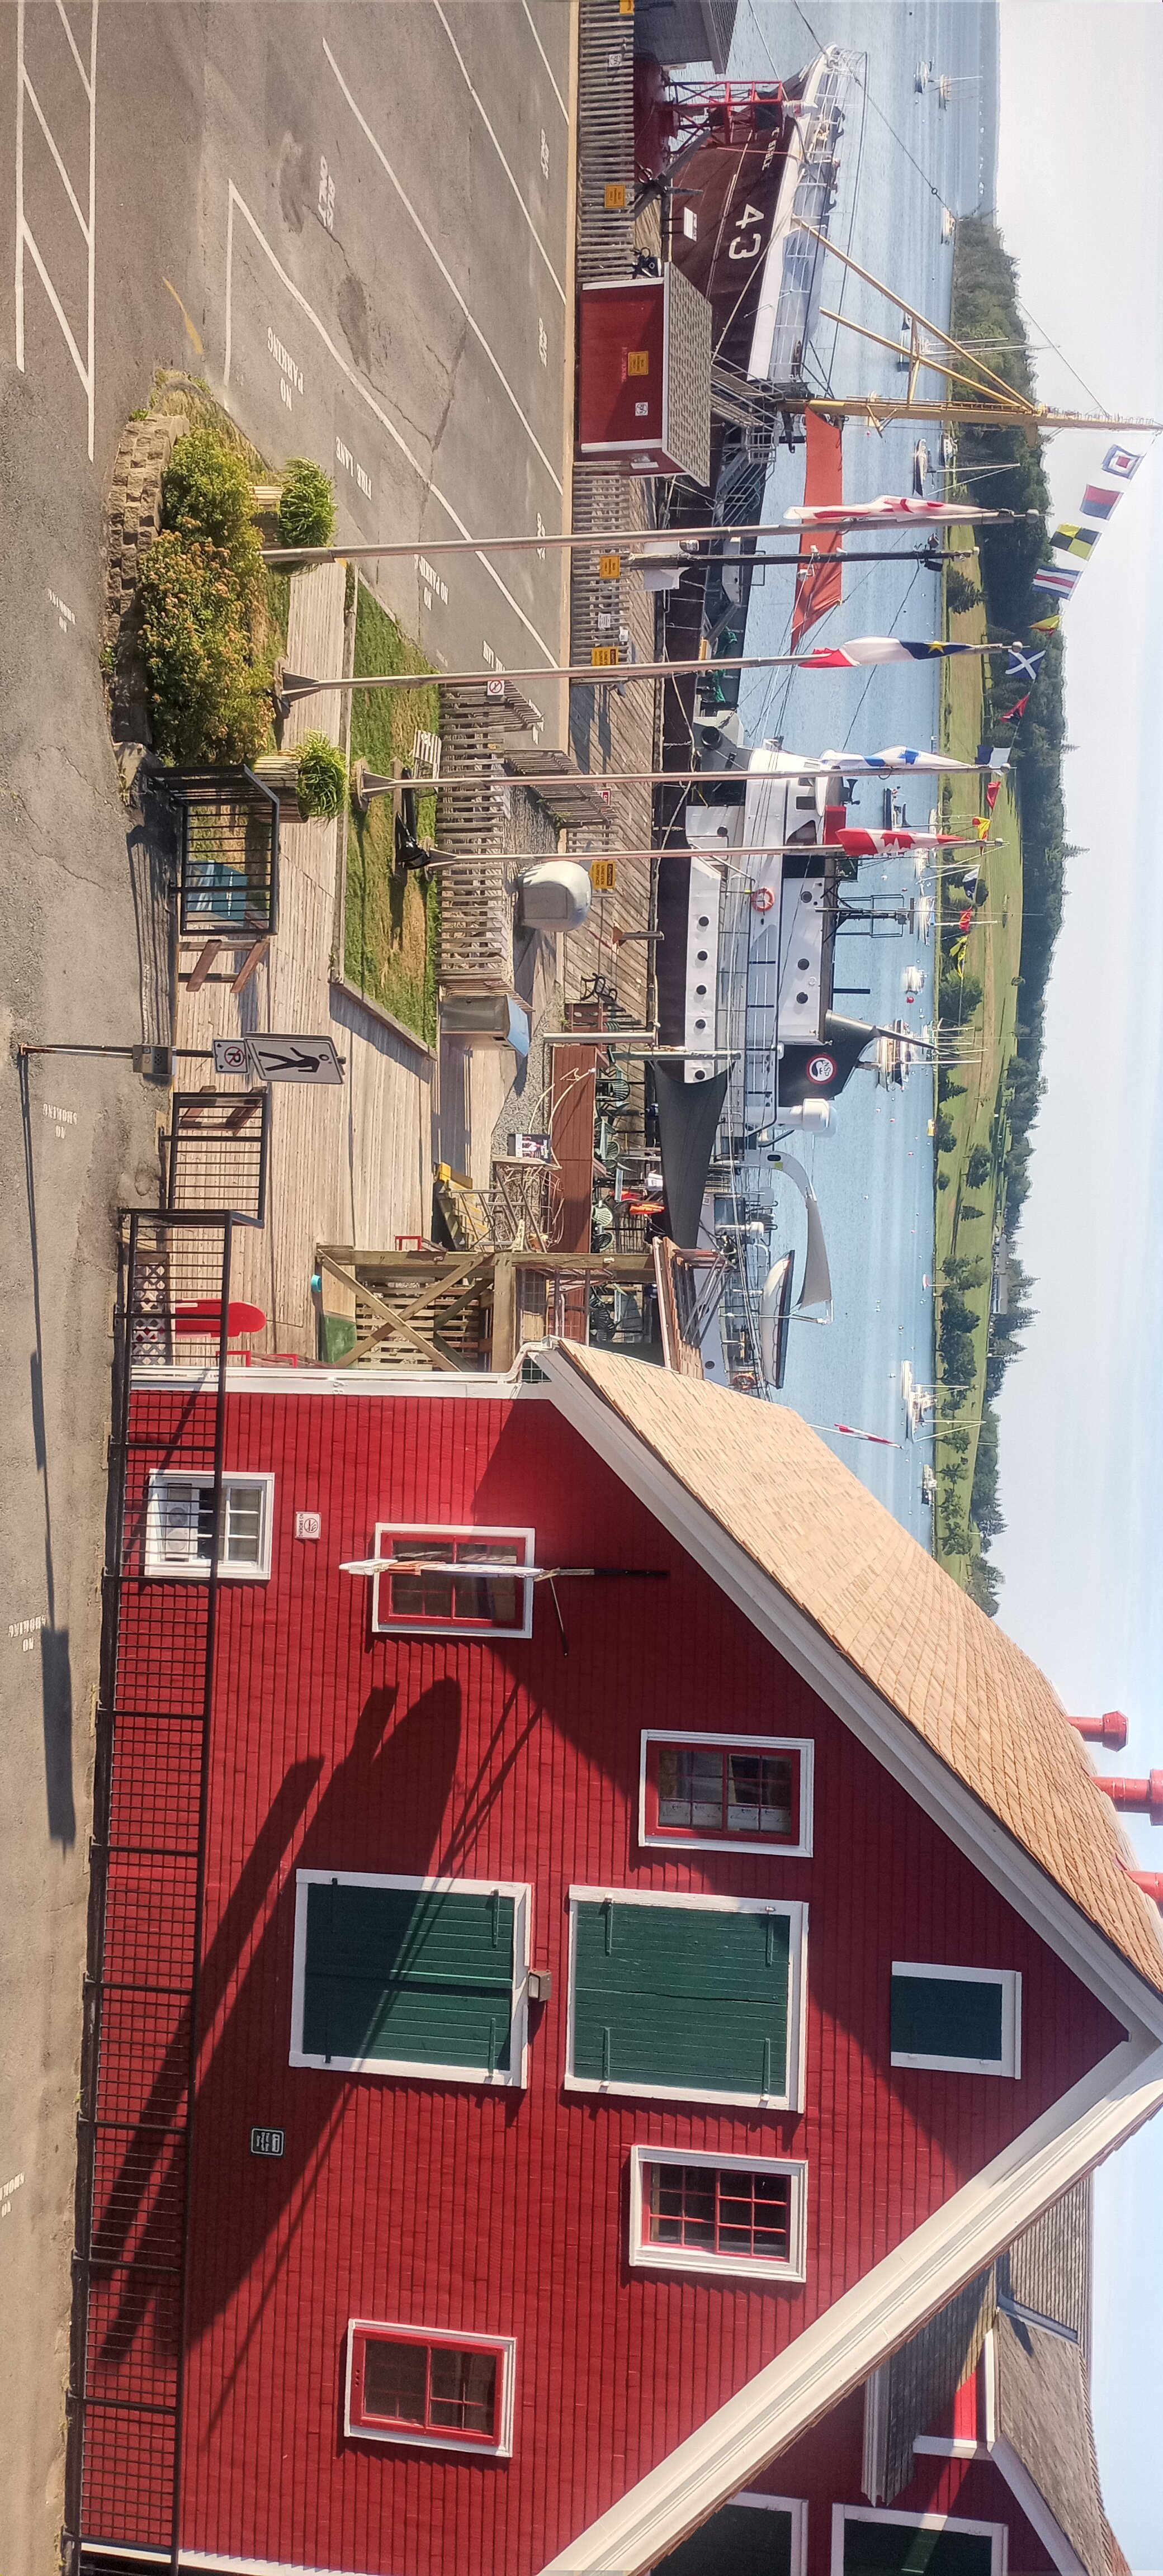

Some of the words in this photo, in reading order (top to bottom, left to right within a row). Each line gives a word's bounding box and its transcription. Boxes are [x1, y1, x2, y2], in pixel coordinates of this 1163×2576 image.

[318, 155, 328, 228] ONLY
[326, 174, 335, 233] BUS
[729, 203, 765, 259] 43
[267, 326, 304, 396] PARKING
[280, 377, 292, 412] NO
[335, 436, 354, 477] LANE
[356, 463, 372, 501] FIRE
[423, 586, 432, 611] NO
[58, 616, 67, 633] NO
[143, 964, 151, 982] NO
[42, 1103, 77, 1125] SMOKING
[55, 1125, 65, 1140] NO
[7, 1614, 46, 1639] SMOKING
[22, 1636, 35, 1652] NO
[1, 2200, 11, 2218] NO
